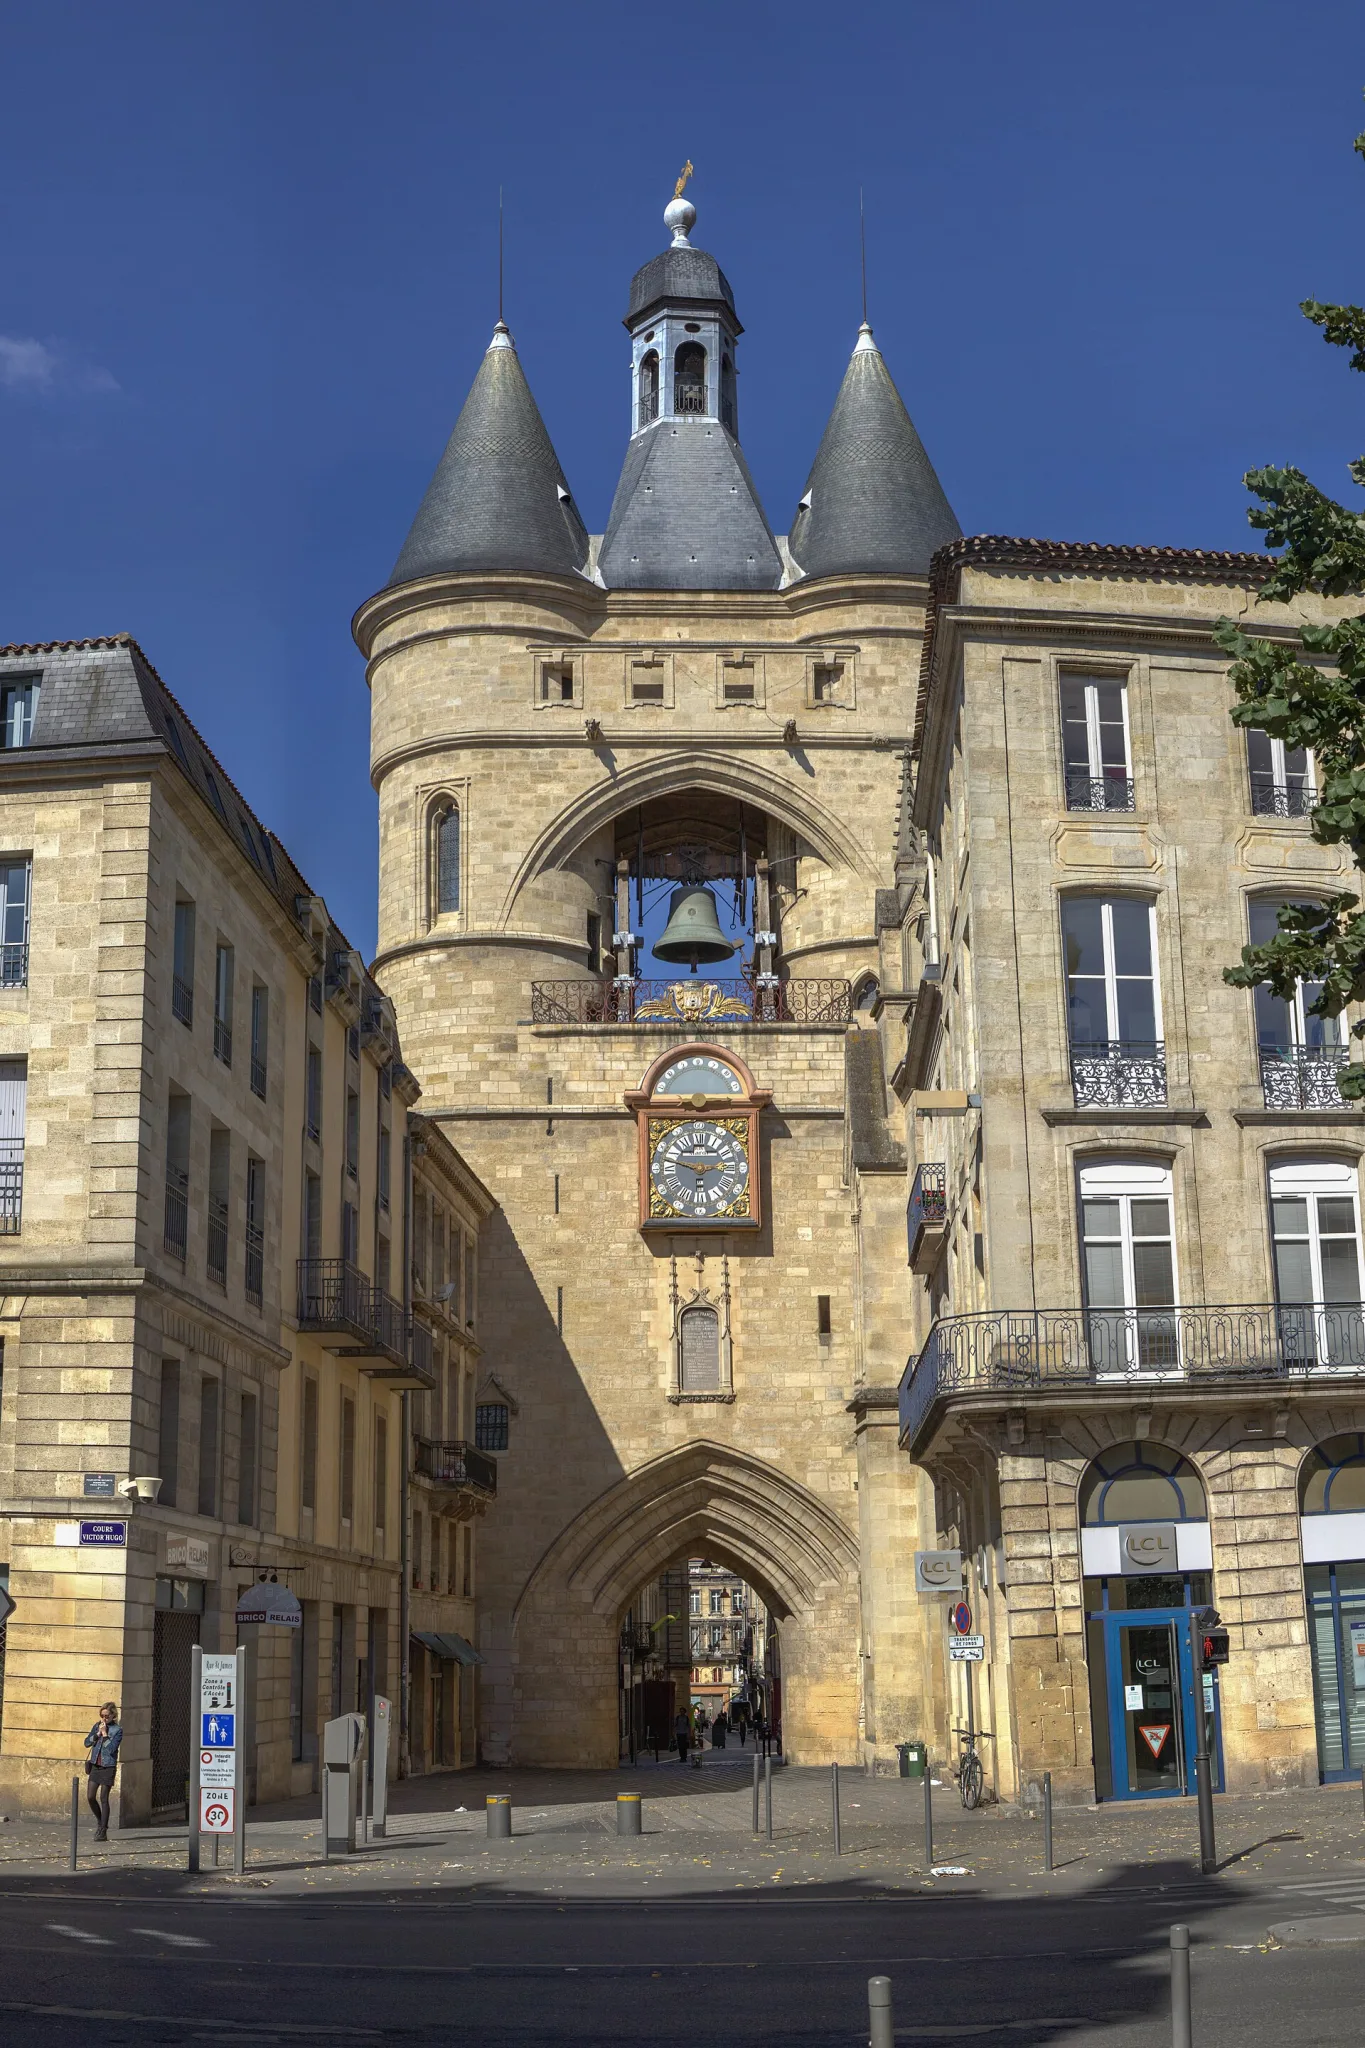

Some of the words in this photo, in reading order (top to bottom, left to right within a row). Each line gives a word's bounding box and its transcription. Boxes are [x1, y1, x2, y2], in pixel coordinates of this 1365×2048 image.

[1130, 1536, 1170, 1551] LCL
[168, 1546, 186, 1564] BRICO
[188, 1546, 208, 1564] RELAIS
[924, 1562, 956, 1572] LCL
[270, 1614, 300, 1622] RELAIS
[206, 1660, 214, 1670] Rue
[220, 1661, 233, 1671] James
[1138, 1660, 1160, 1668] LCL
[210, 1811, 223, 1820] 30
